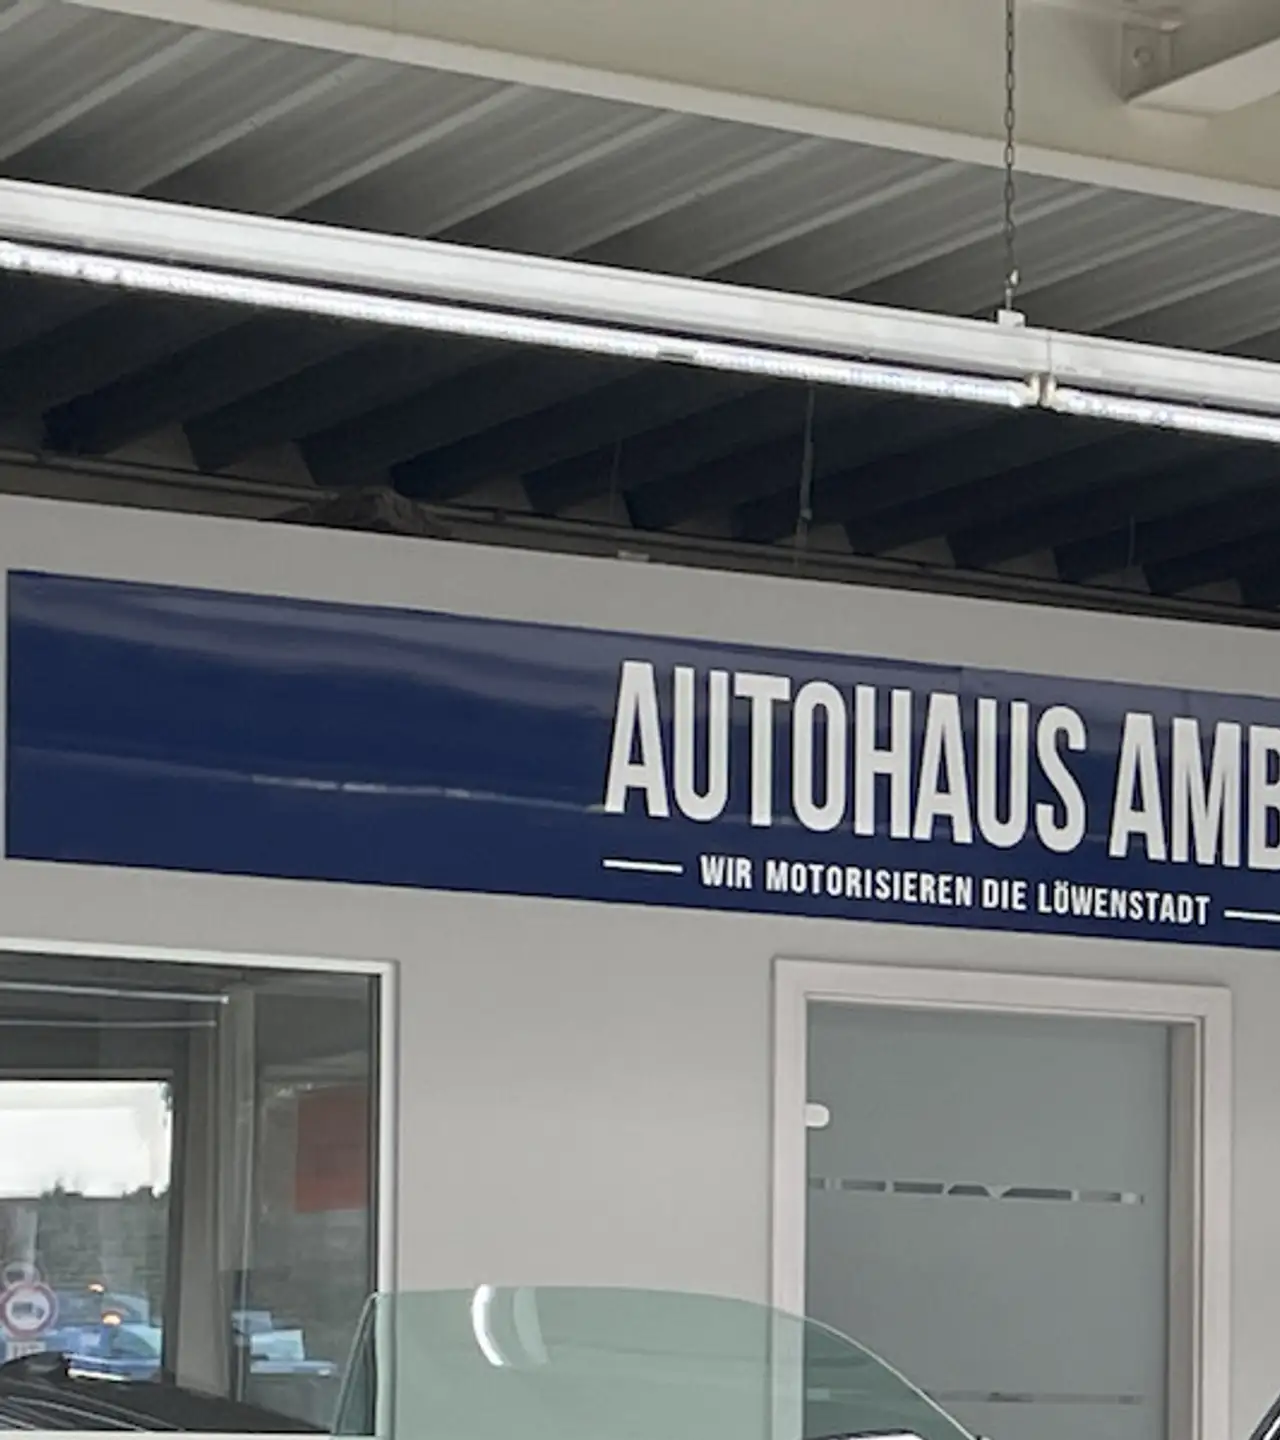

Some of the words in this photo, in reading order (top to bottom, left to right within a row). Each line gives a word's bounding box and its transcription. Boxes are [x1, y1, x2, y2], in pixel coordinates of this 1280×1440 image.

[603, 660, 1087, 851] AUTOHAUS
[700, 854, 753, 890] WIR
[765, 859, 972, 908] MOTORISIEREN
[982, 877, 1027, 911] DIE
[1037, 881, 1211, 925] LÖWENSTADT
